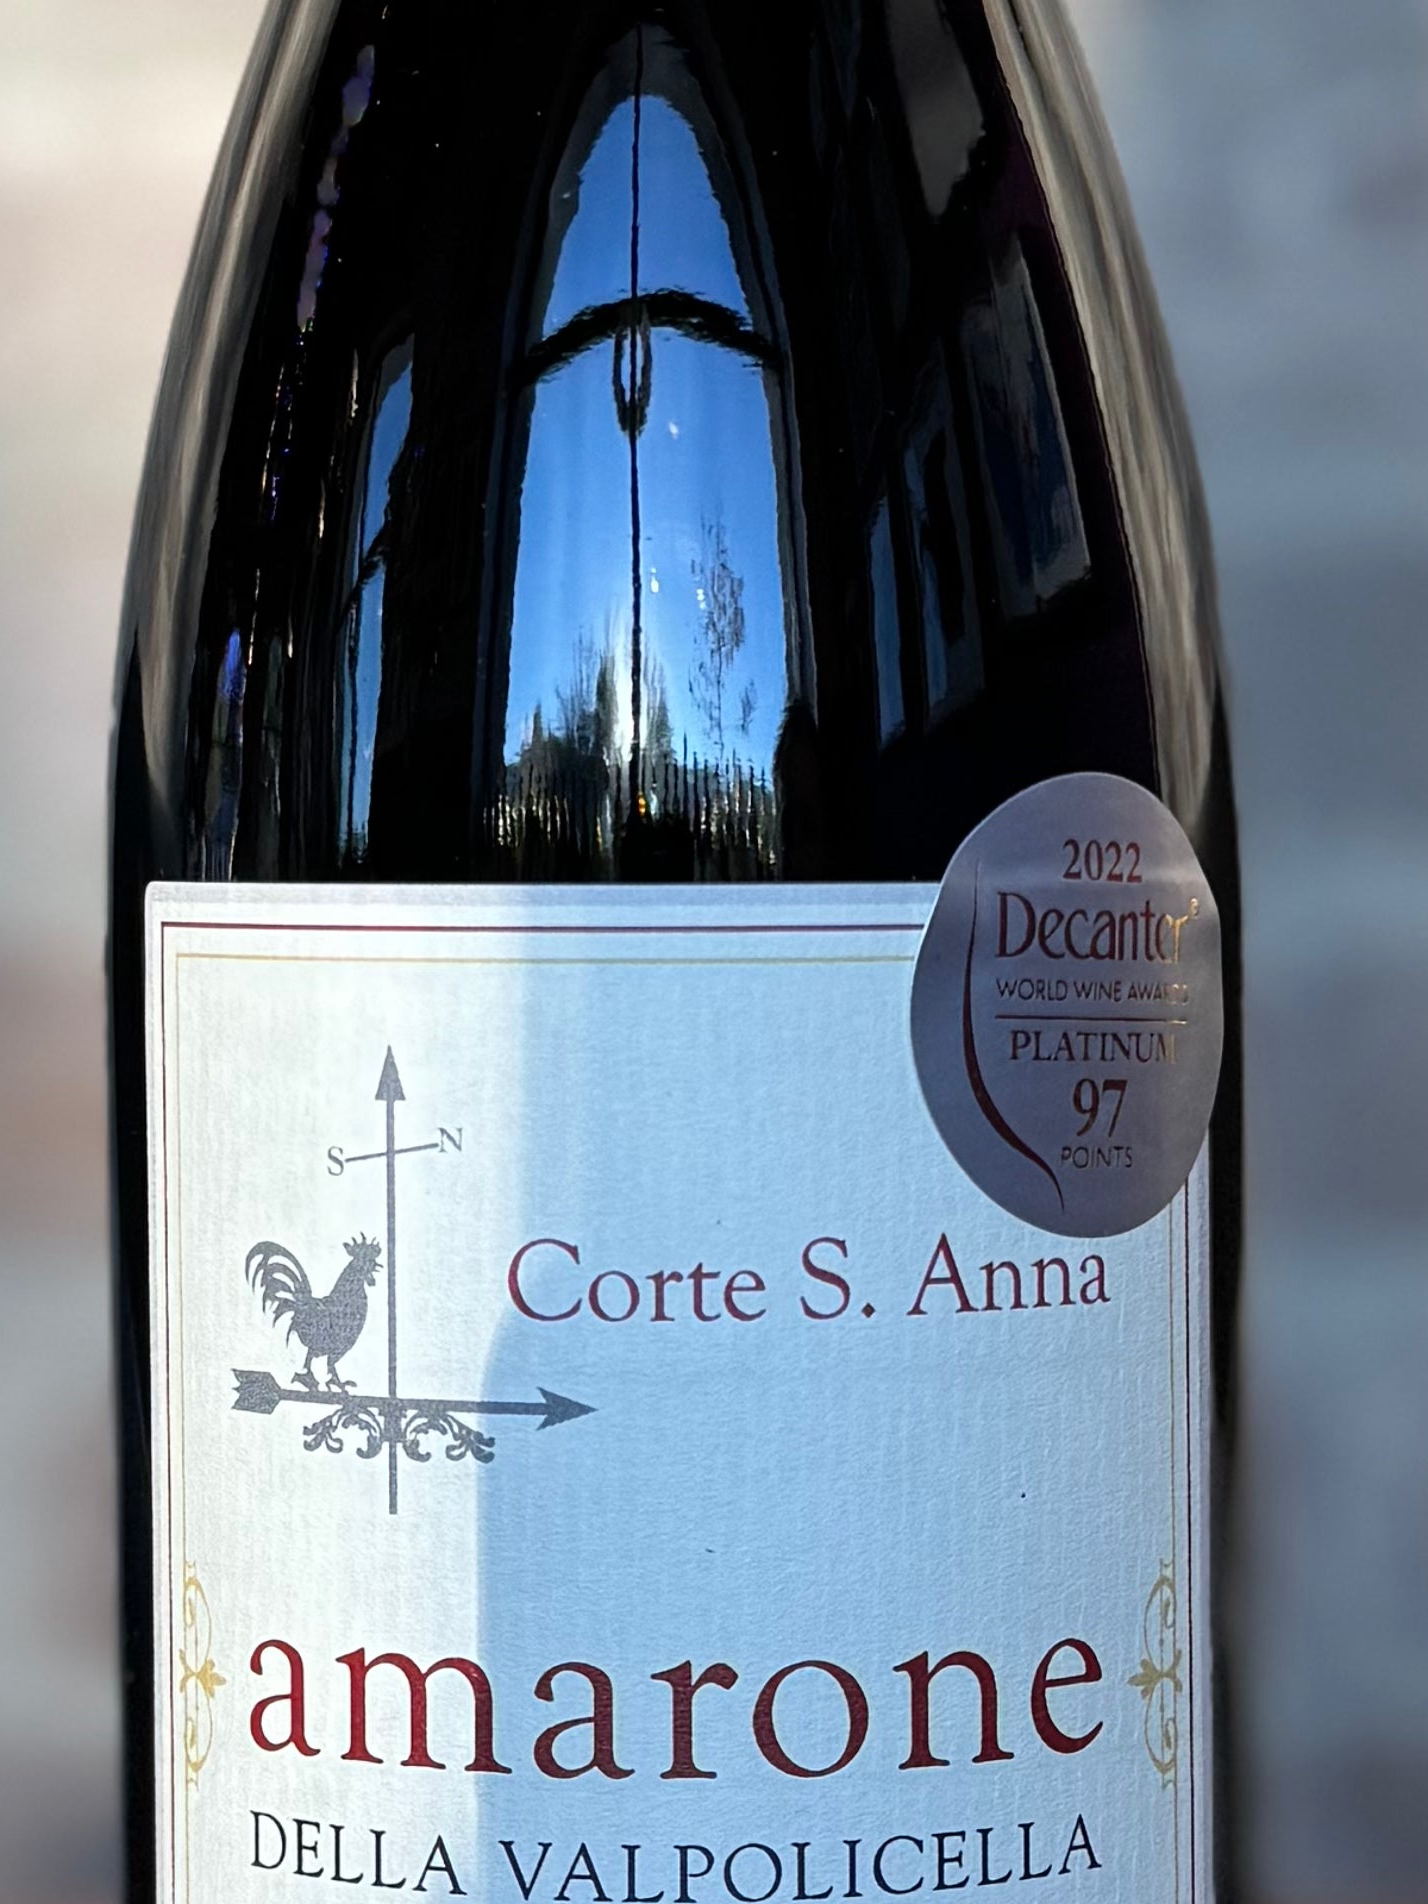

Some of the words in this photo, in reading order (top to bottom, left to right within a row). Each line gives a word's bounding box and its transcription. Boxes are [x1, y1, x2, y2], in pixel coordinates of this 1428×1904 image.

[1062, 839, 1142, 883] 2022
[996, 978, 1068, 1002] WORLD
[1073, 980, 1122, 1003] WINE
[1010, 1029, 1177, 1064] PLATINUM
[1073, 1078, 1128, 1138] 97
[1061, 1146, 1133, 1169] POINTS
[507, 1238, 766, 1323] Corte
[800, 1235, 876, 1321] S.
[906, 1232, 1113, 1317] Anna
[248, 1636, 1105, 1781] amarone
[250, 1810, 468, 1896] DELLA
[500, 1813, 1103, 1904] VALPOLICELLA
